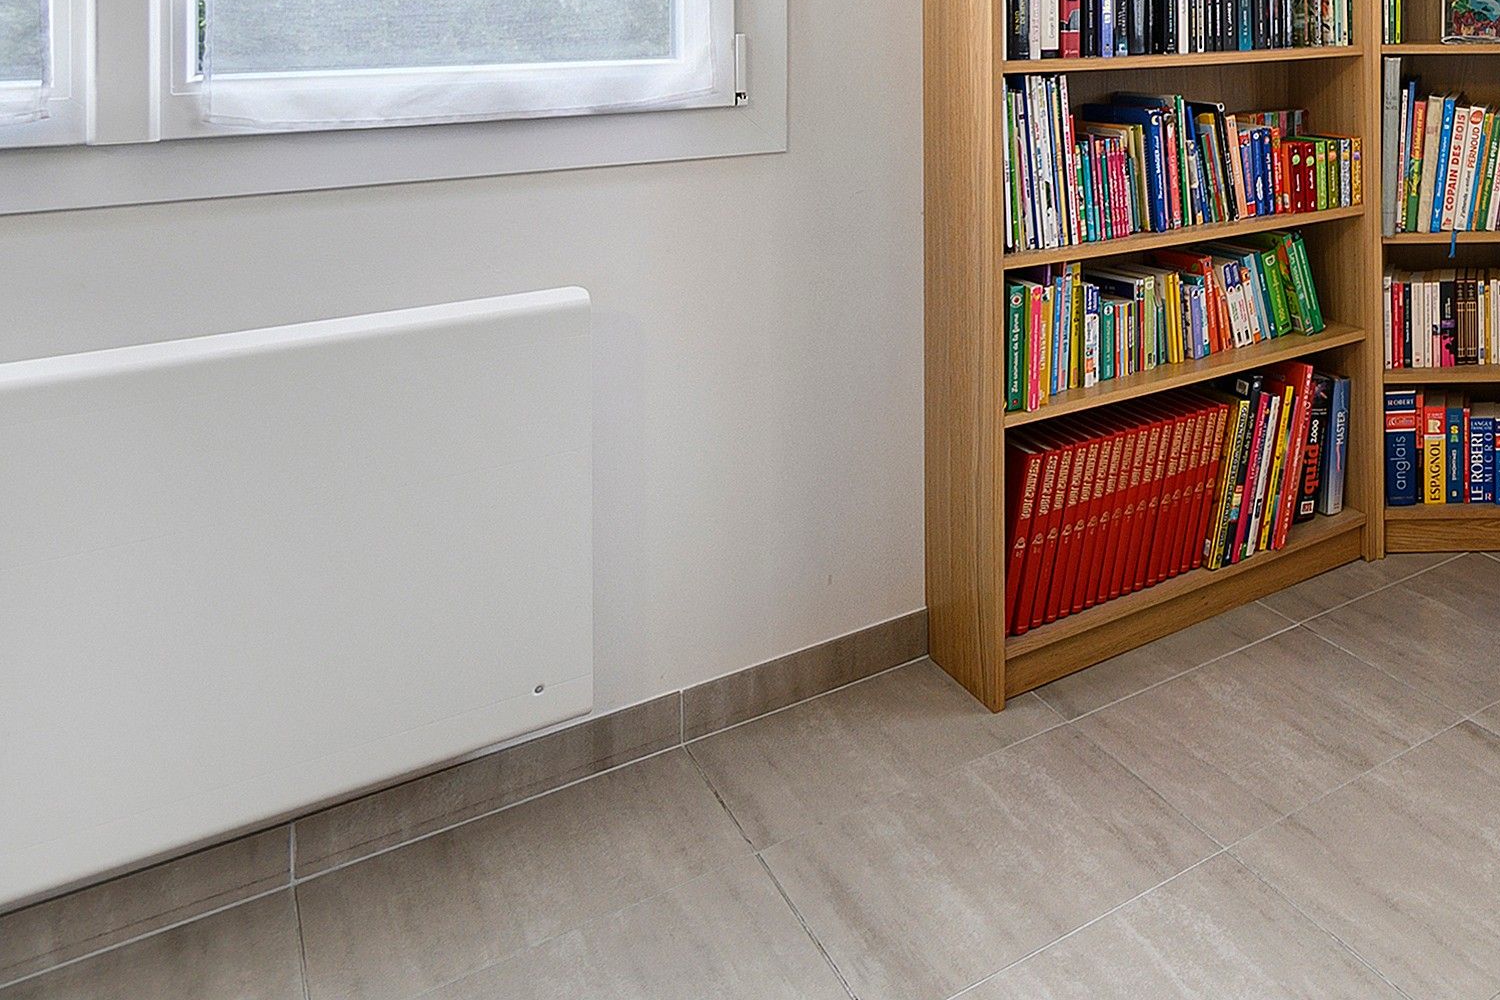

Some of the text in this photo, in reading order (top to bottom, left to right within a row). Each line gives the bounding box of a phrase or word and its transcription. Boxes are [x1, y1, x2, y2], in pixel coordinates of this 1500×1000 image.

[1445, 115, 1465, 211] COPAIN DES BOIS
[1467, 127, 1480, 168] PERNOUD
[1336, 412, 1346, 445] MASTER
[1388, 398, 1414, 406] ROBERT
[1222, 407, 1248, 526] GUINNESS WORLD RECORDS
[1303, 420, 1319, 494] quid 2000
[1390, 436, 1410, 490] anglais
[1430, 441, 1441, 501] ESPAGNOL
[1471, 432, 1484, 501] LE ROBERT
[1484, 432, 1493, 482] MICRO
